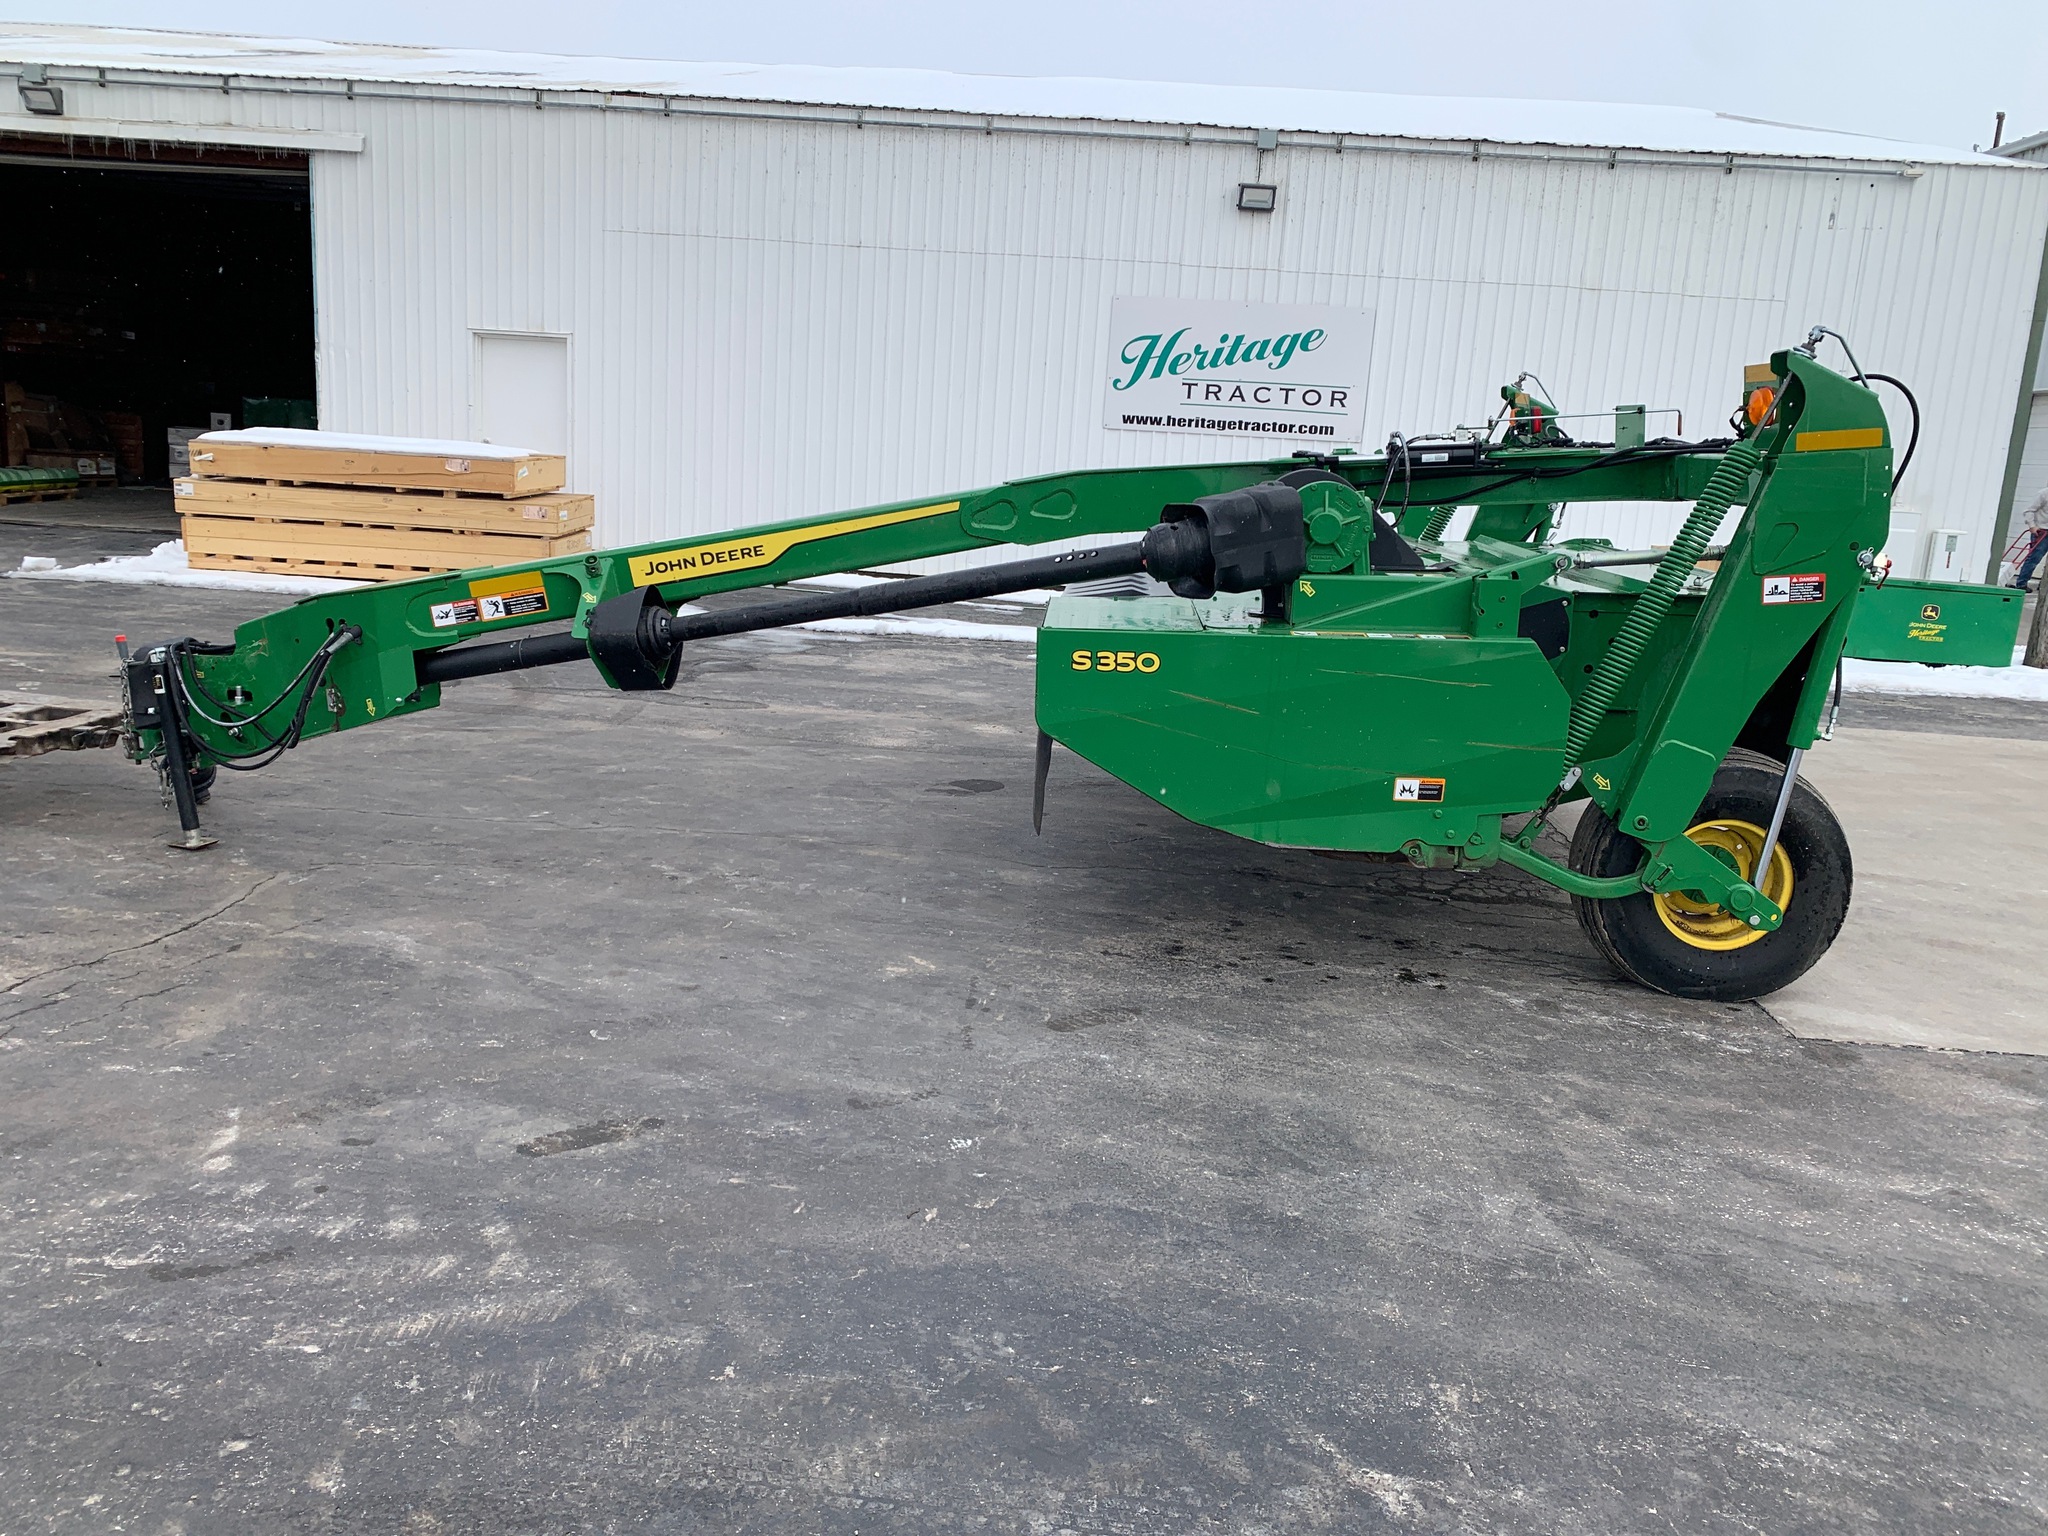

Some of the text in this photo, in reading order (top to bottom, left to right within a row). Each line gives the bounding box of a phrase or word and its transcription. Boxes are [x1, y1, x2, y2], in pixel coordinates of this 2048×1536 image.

[1112, 327, 1328, 391] Heritage
[1181, 382, 1348, 408] TRACTOR
[1121, 413, 1335, 436] www.heritagetractor.com
[644, 544, 766, 577] JOHN DEERE
[1071, 649, 1162, 674] S 350
